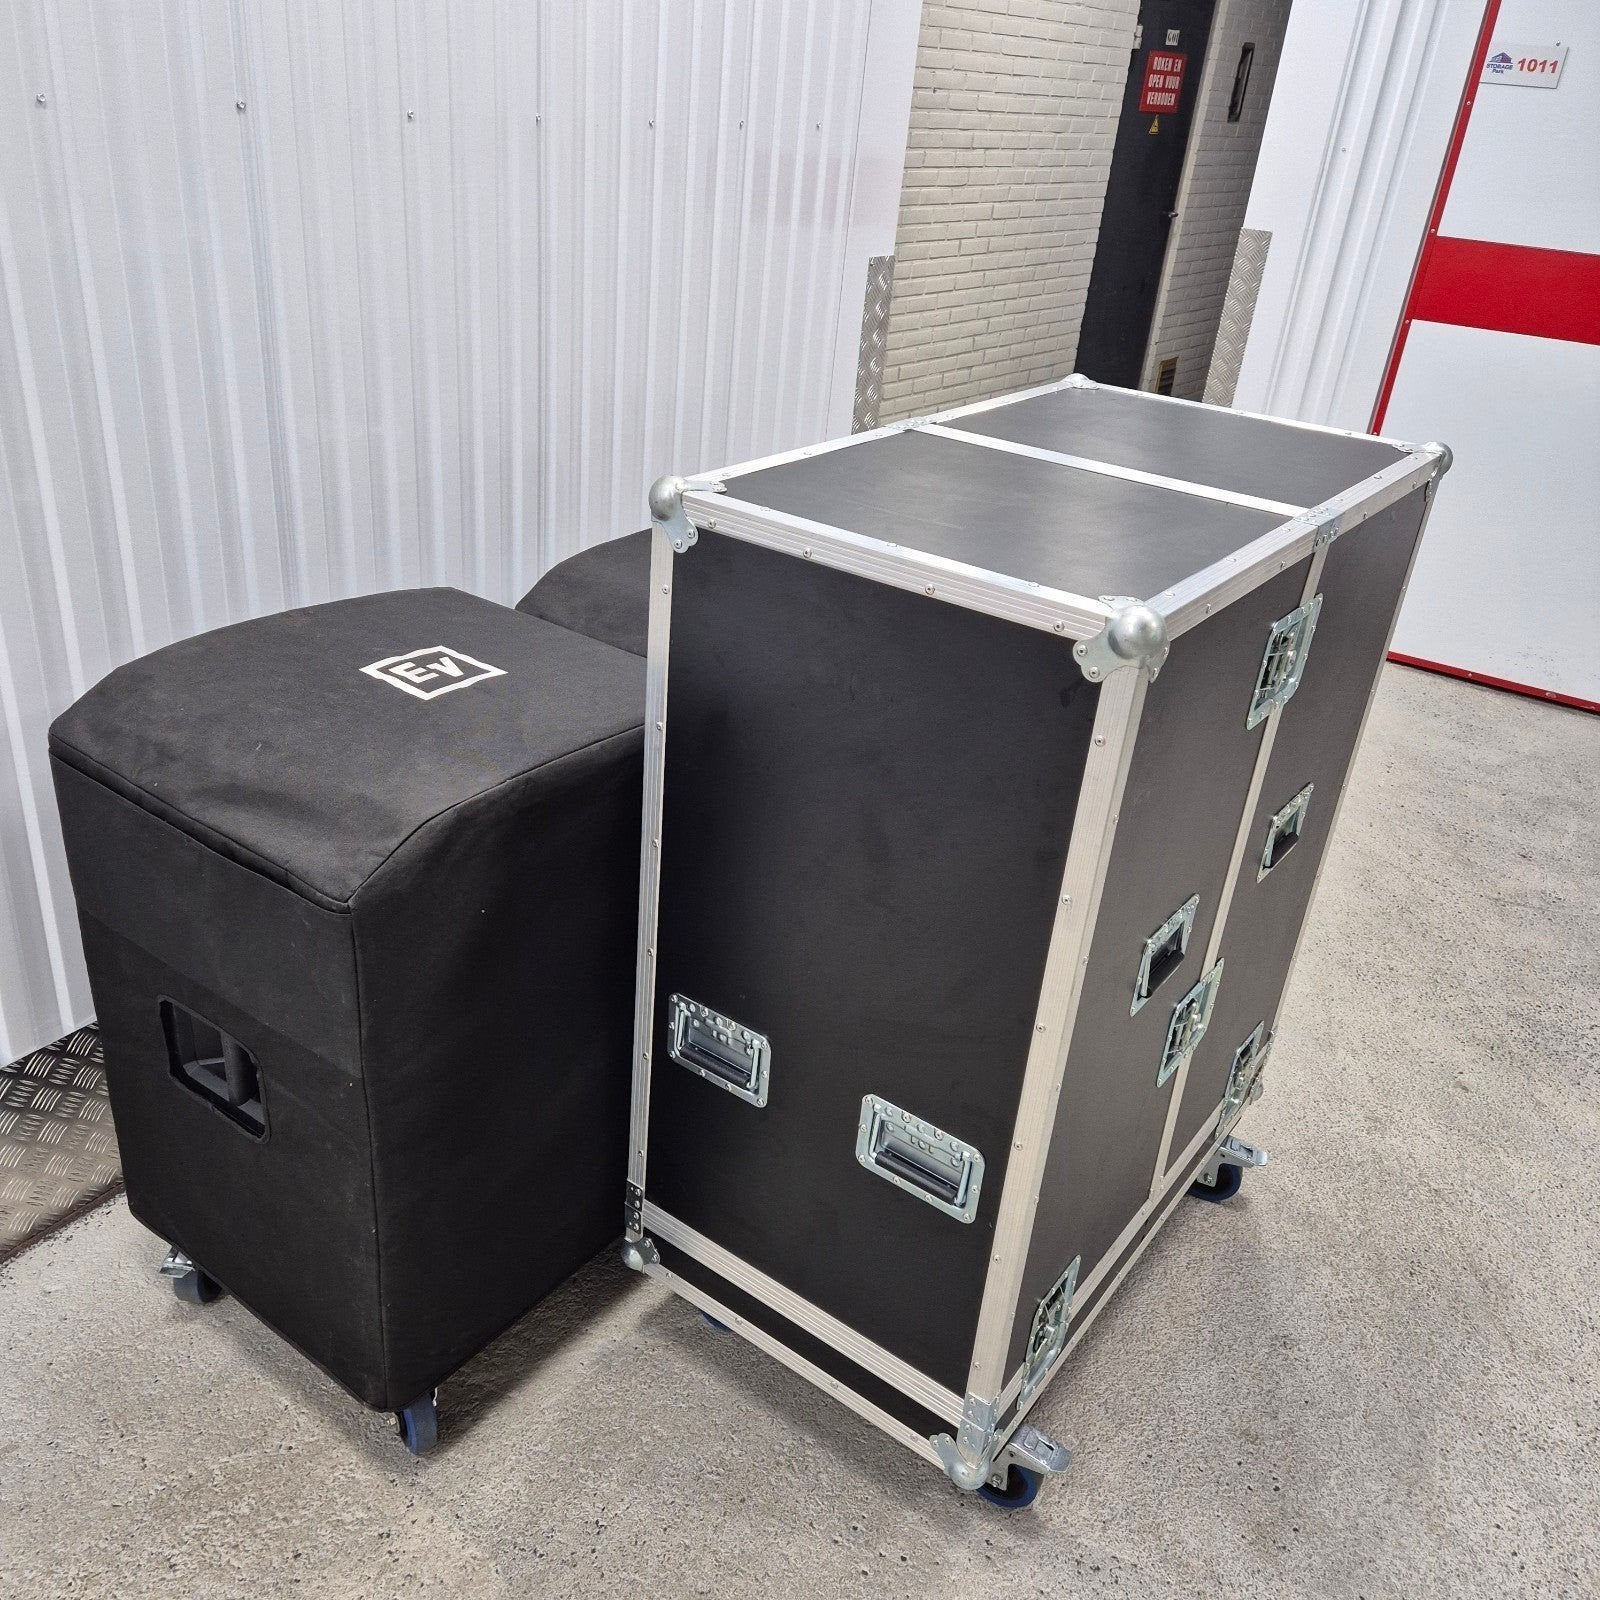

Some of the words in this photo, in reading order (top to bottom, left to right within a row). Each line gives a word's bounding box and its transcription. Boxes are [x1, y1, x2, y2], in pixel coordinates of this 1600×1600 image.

[1153, 57, 1173, 71] ROKEN
[1174, 59, 1182, 72] EN
[1518, 59, 1558, 73] 1011
[1148, 74, 1164, 88] OPEN
[1147, 92, 1176, 106] VERBODEN
